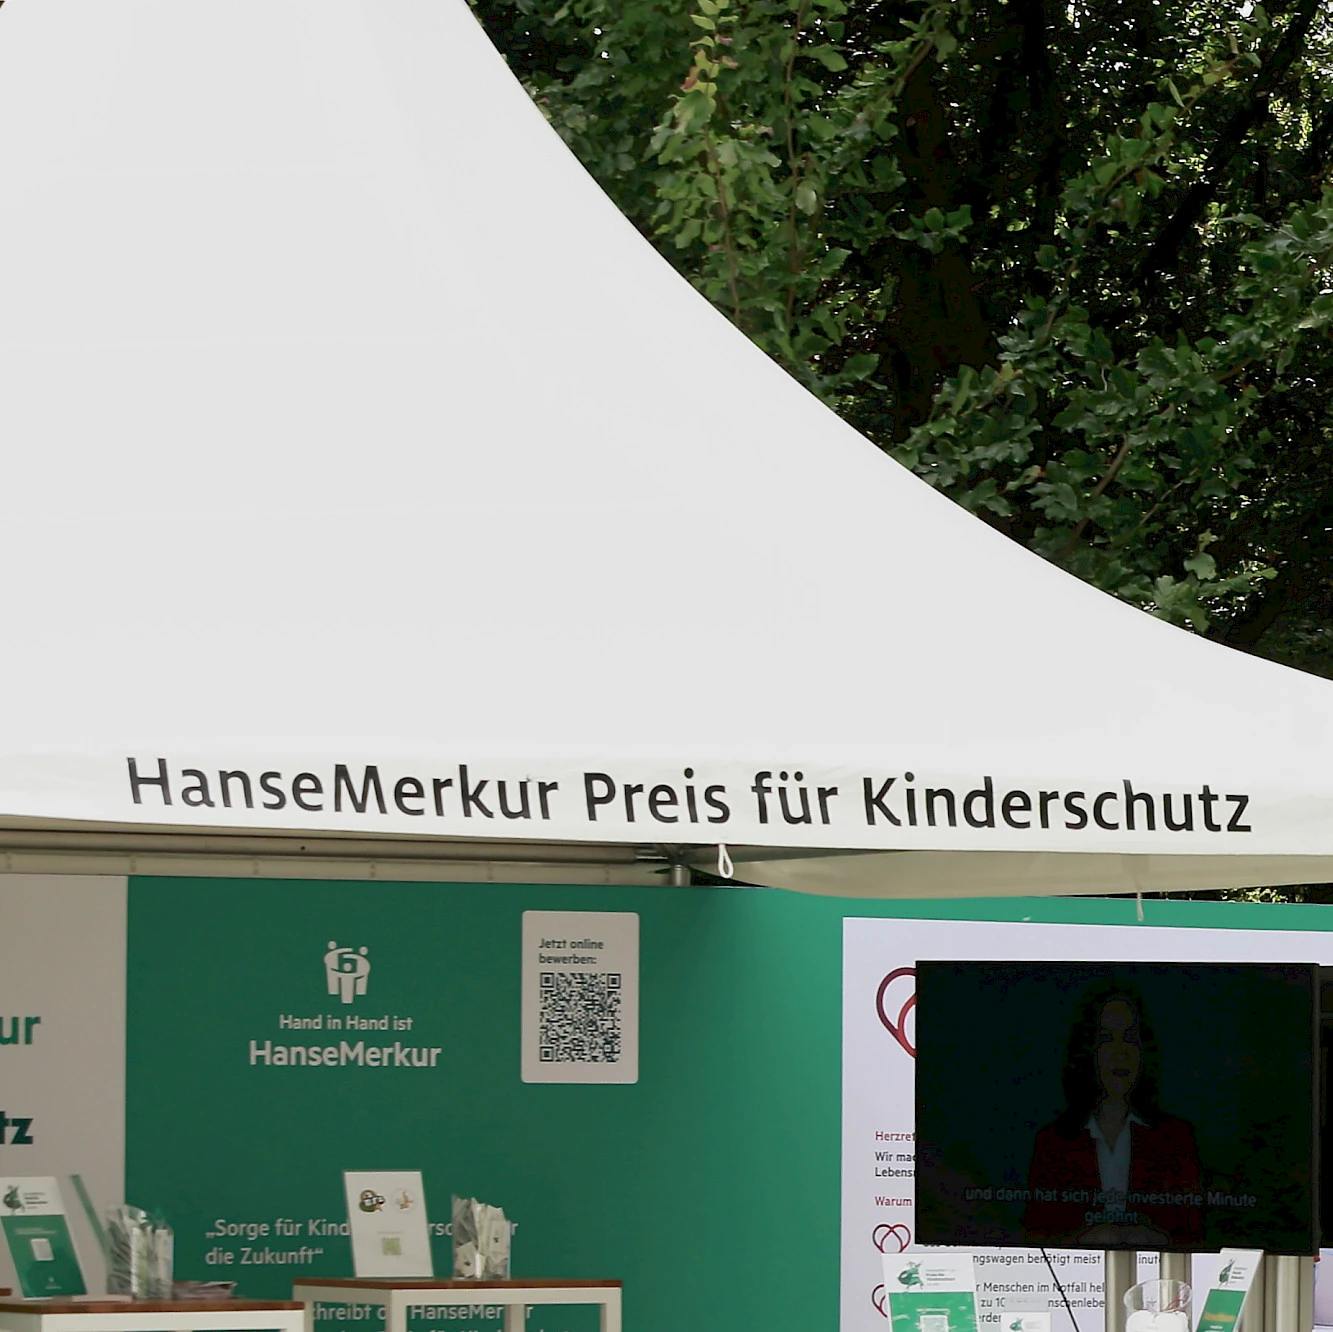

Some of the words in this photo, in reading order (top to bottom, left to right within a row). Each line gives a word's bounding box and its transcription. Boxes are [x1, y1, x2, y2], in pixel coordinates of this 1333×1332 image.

[127, 758, 558, 819] HanseMerkur
[584, 768, 730, 823] Preis
[751, 771, 838, 824] für
[863, 772, 1251, 832] Kinderschutz
[539, 939, 567, 950] Jetzt
[570, 939, 603, 949] online
[539, 953, 596, 964] bewerben:
[279, 1015, 322, 1031] Hand
[328, 1015, 341, 1030] in
[346, 1015, 388, 1031] Hand
[393, 1016, 412, 1031] ist
[249, 1040, 441, 1067] HanseMerkur
[875, 1152, 893, 1162] Wir
[875, 1196, 912, 1206] Warum
[965, 1188, 990, 1200] und
[1035, 1189, 1057, 1202] hat
[1061, 1189, 1089, 1203] sich
[1207, 1190, 1257, 1207] Minute
[205, 1219, 270, 1240] „Sorge
[275, 1218, 302, 1236] für
[205, 1247, 234, 1265] die
[240, 1246, 323, 1265] Zukunft“
[1027, 1253, 1070, 1266] benötigt
[1073, 1253, 1100, 1264] meist
[983, 1282, 1033, 1293] Menschen
[1037, 1282, 1050, 1293] im
[1053, 1282, 1087, 1293] Notfall
[411, 1305, 534, 1320] HanseMerr
